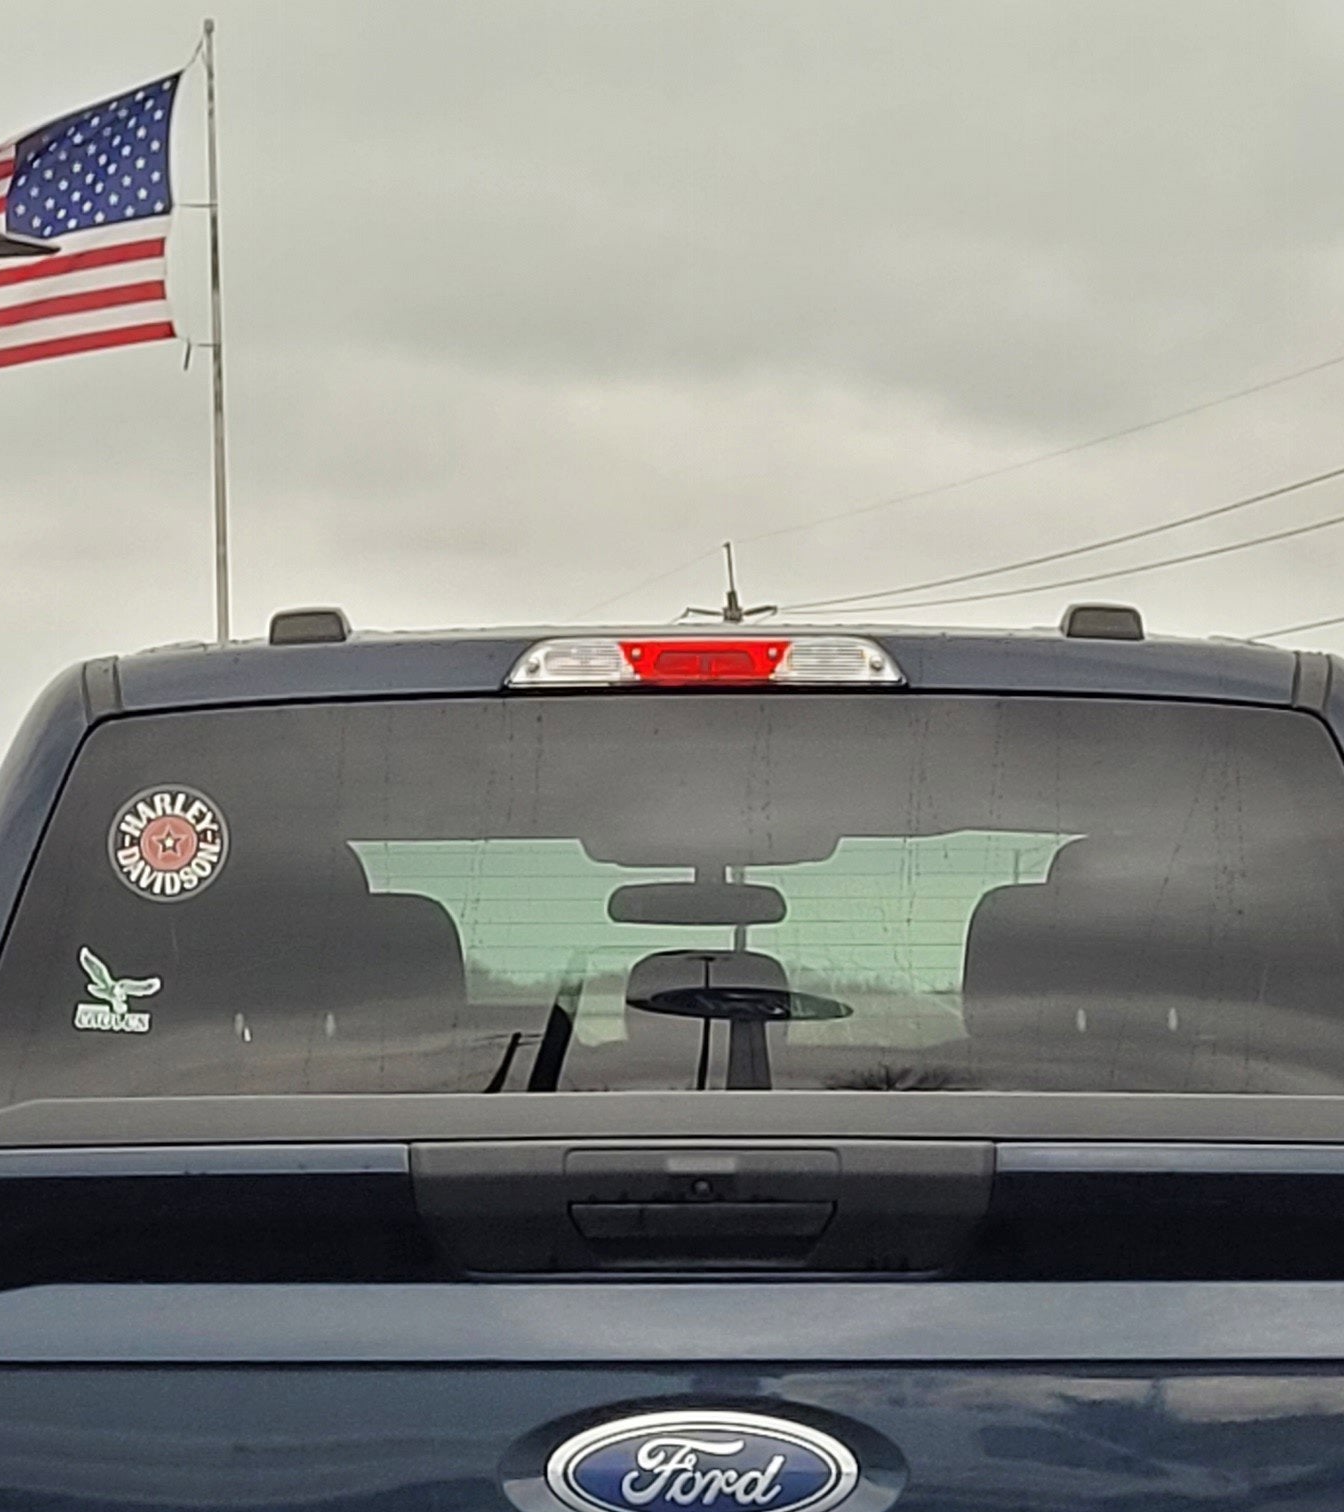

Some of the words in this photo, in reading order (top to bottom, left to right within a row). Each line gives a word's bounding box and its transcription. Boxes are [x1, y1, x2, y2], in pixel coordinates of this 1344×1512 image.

[119, 792, 219, 838] HARLEY
[116, 838, 221, 895] DAVIDSON
[622, 1436, 787, 1505] Ford
